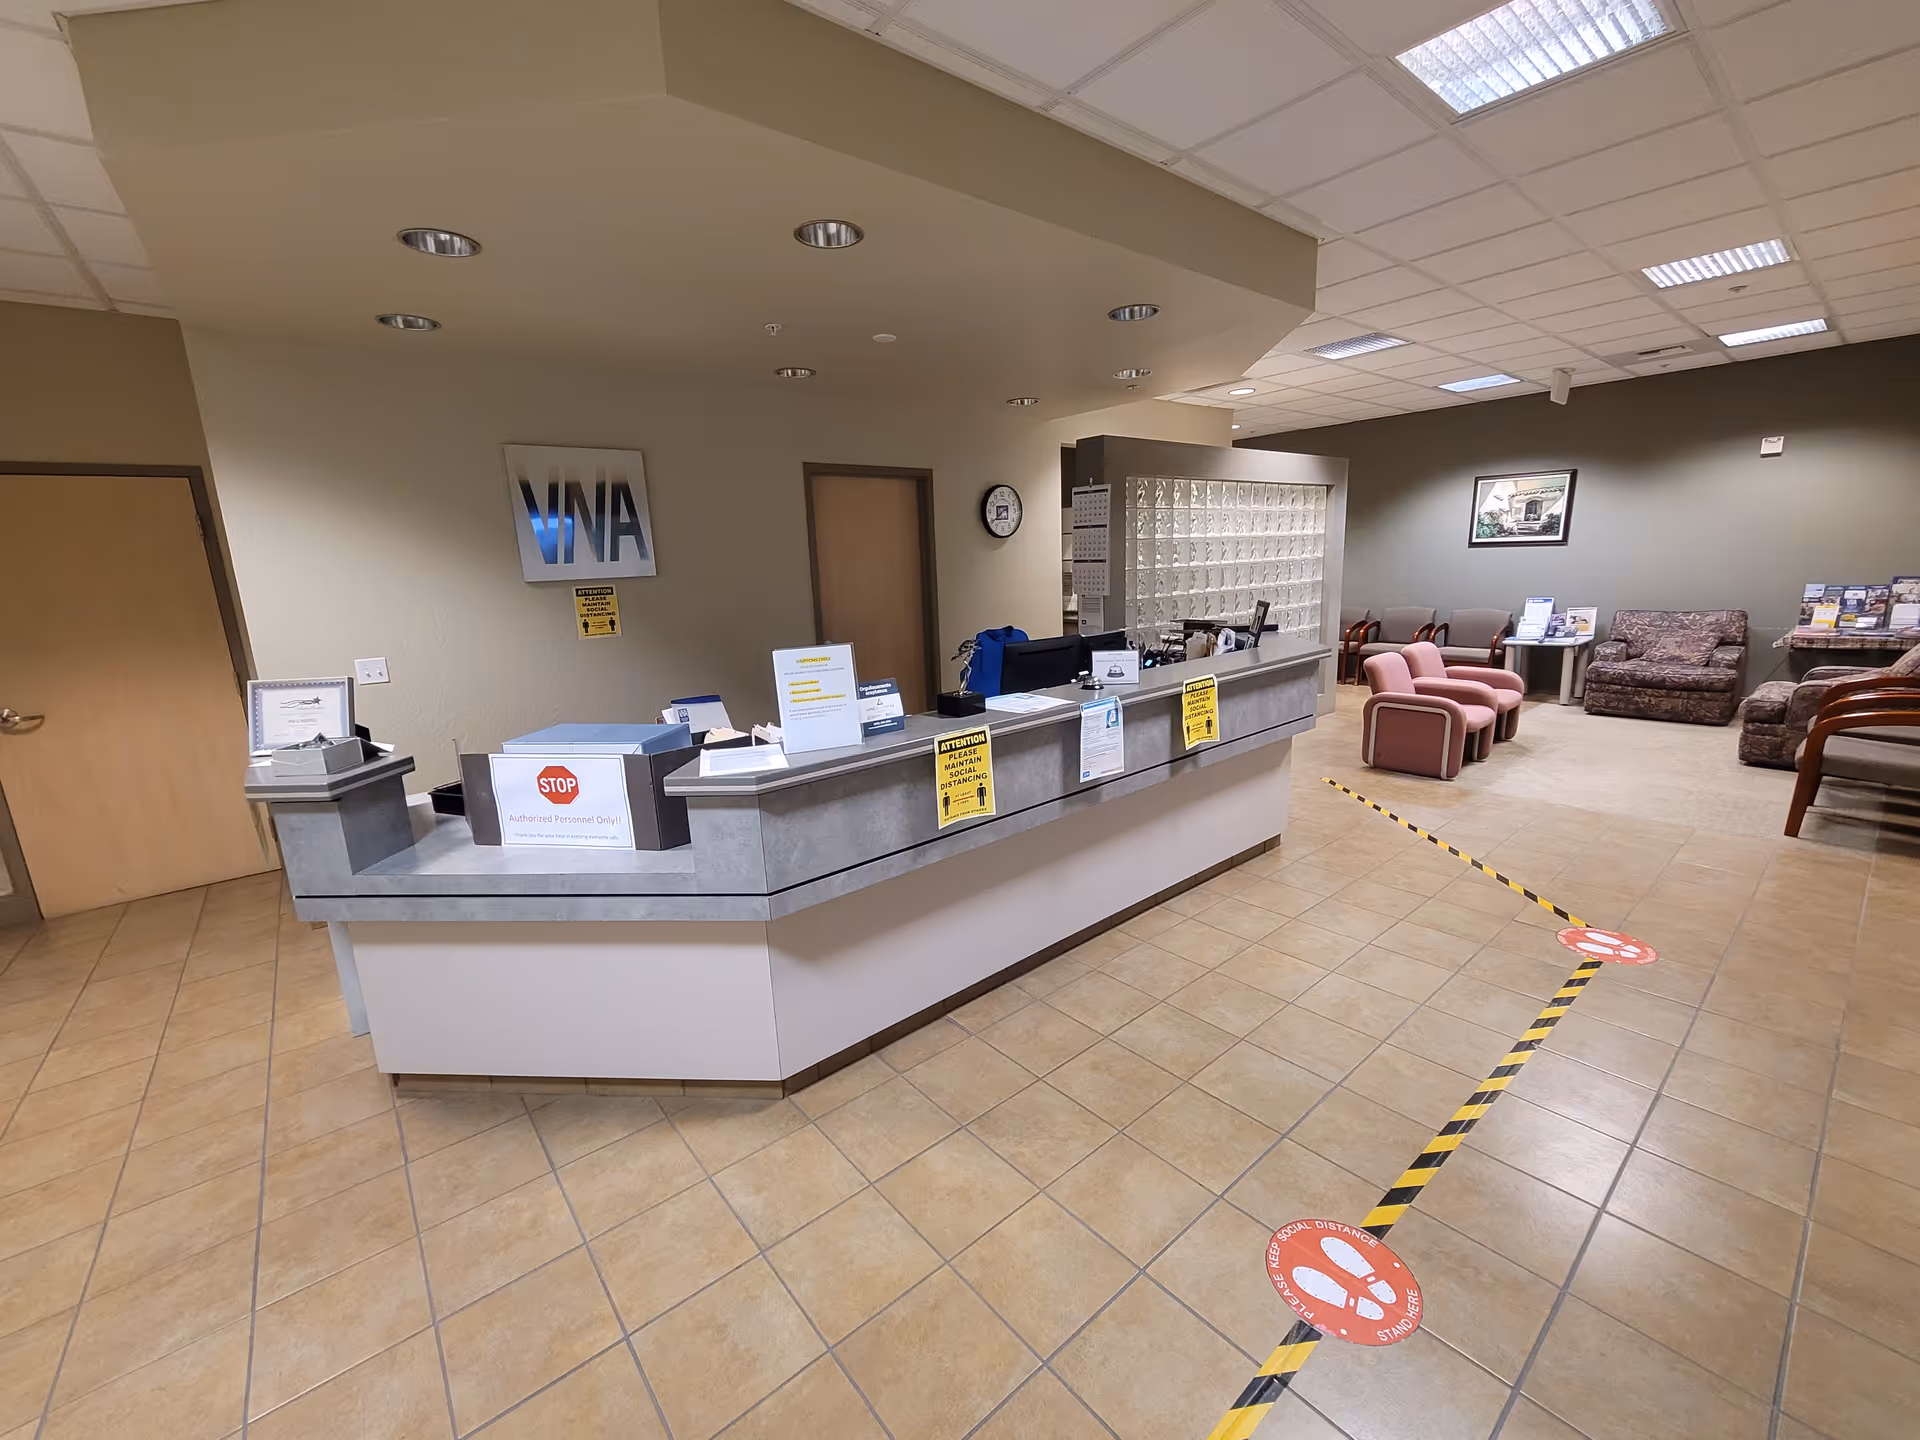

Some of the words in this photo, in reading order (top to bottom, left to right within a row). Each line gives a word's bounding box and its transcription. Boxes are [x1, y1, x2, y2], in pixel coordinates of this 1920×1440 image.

[514, 466, 651, 565] VNA
[577, 588, 612, 596] ATTENTION
[1186, 678, 1214, 692] ATTENTION
[1187, 696, 1211, 706] MAINTAIN
[1190, 689, 1209, 699] PLEASE
[1184, 708, 1214, 721] DISTANCING
[1189, 703, 1207, 712] SOCIAL
[940, 733, 986, 752] ATTENTION
[948, 747, 978, 761] PLEASE
[944, 755, 982, 771] MAINTAIN
[949, 766, 977, 779] SOCIAL
[539, 777, 577, 793] STOP
[940, 772, 988, 791] DISTANCING
[509, 814, 552, 823] Authorized
[554, 814, 595, 824] Personnel
[1276, 1221, 1312, 1242] SOCIAL
[1315, 1220, 1378, 1249] DISTANCE
[1269, 1242, 1281, 1269] KEEP
[1273, 1273, 1315, 1320] PLEASE
[1377, 1318, 1413, 1342] STAND
[1405, 1287, 1420, 1320] HERE
